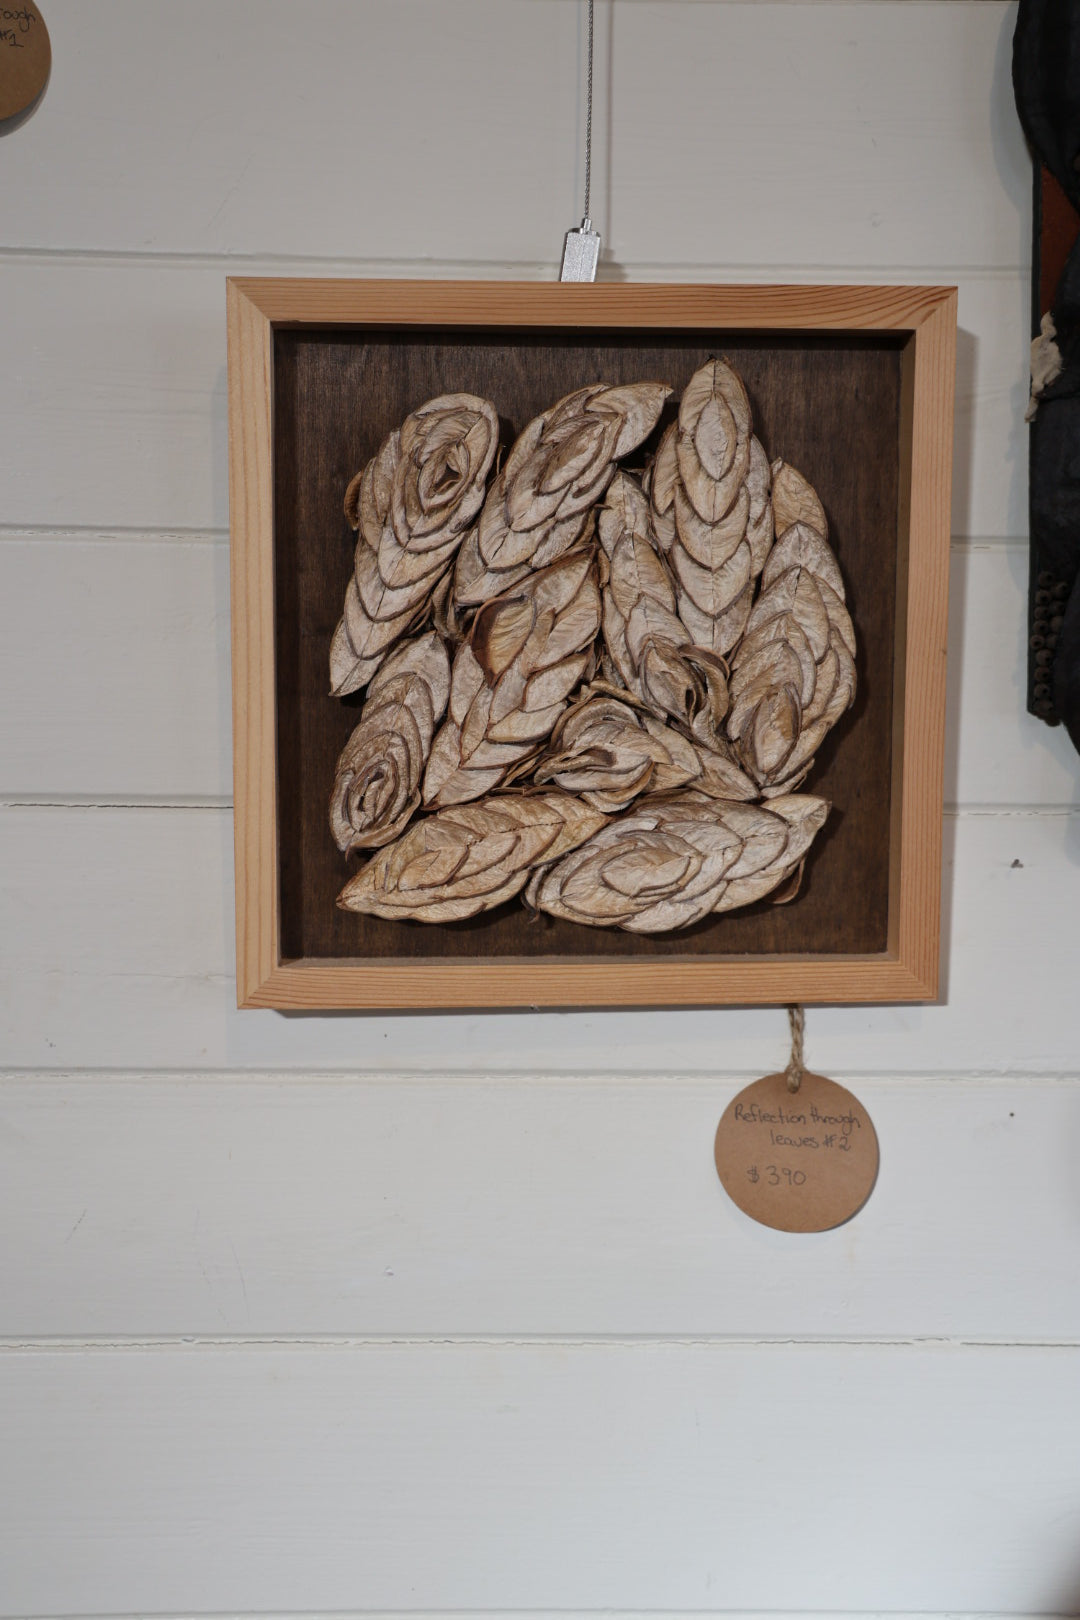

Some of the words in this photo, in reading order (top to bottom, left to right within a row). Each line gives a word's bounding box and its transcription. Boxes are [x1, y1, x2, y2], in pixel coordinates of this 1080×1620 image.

[734, 1103, 806, 1125] Reflection
[810, 1104, 861, 1135] through
[770, 1130, 819, 1148] leaves
